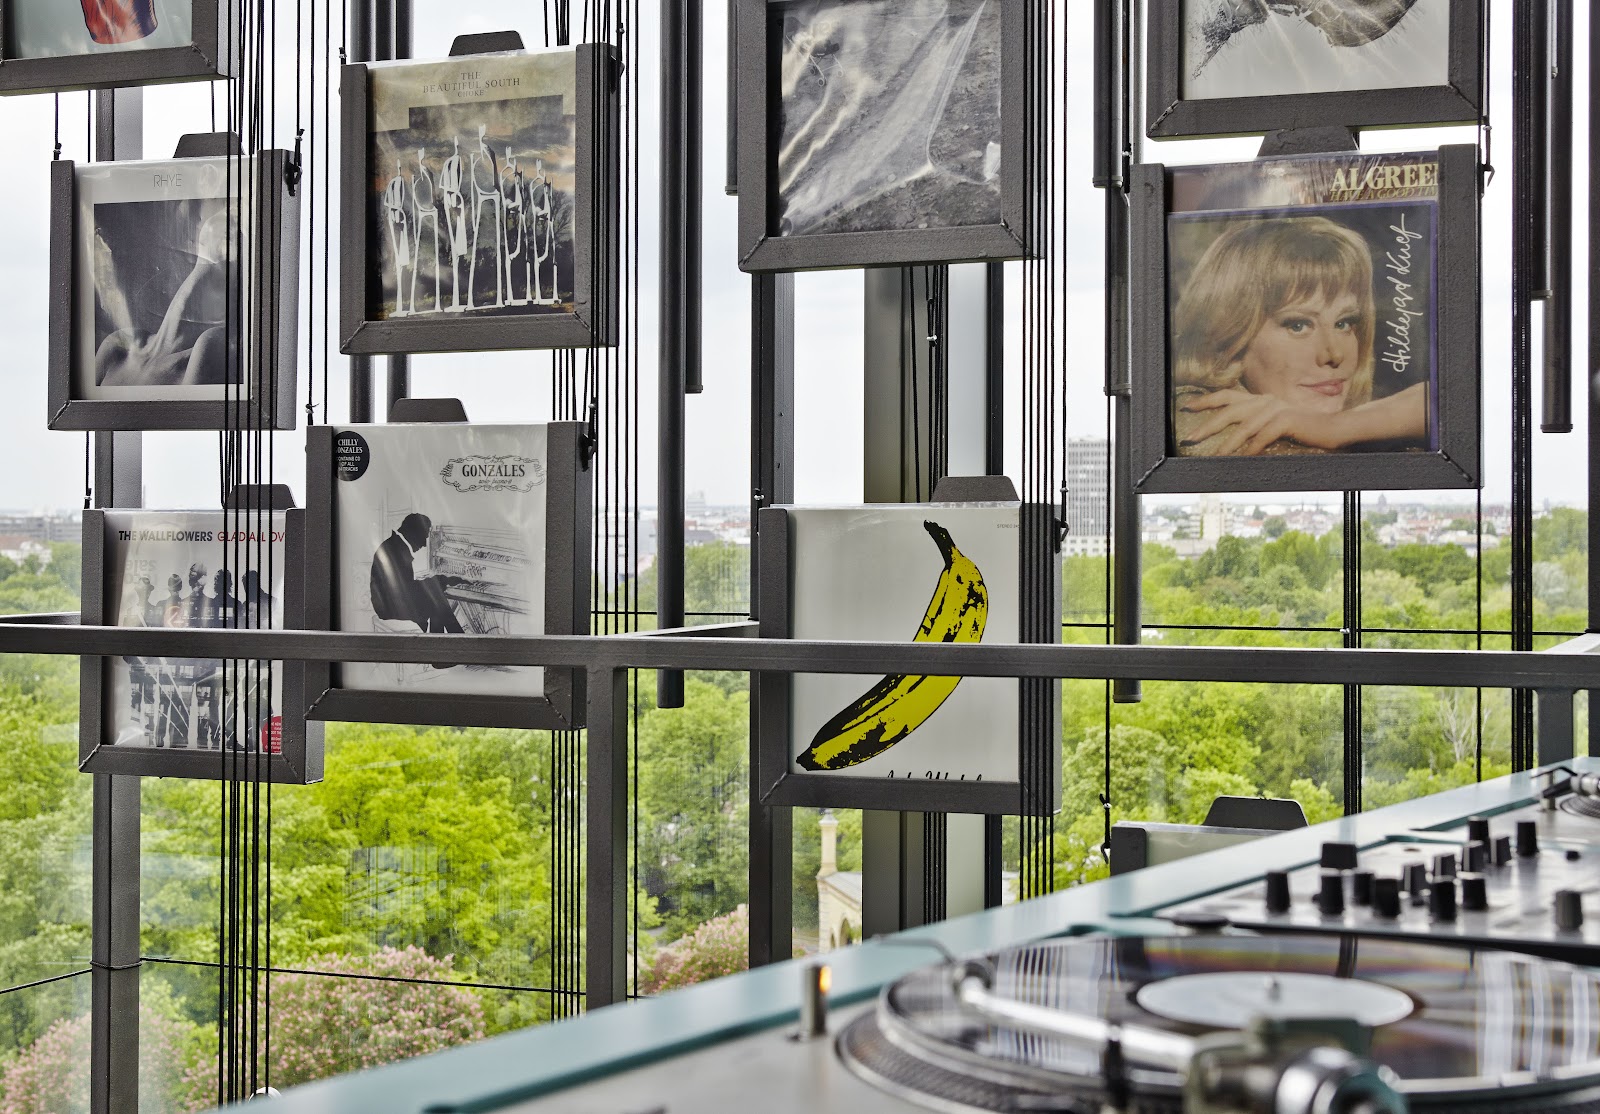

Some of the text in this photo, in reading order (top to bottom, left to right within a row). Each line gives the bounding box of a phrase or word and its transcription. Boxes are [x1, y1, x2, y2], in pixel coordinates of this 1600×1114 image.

[461, 72, 481, 80] THE
[423, 78, 520, 93] BEAUTIFUL SOUTH
[153, 173, 182, 187] RHYE
[1330, 167, 1365, 192] AL
[1377, 187, 1415, 200] GOOD
[337, 438, 359, 446] CHILLY
[337, 446, 363, 454] ONZALES
[462, 464, 526, 477] GONZALES
[118, 530, 137, 541] THE
[139, 530, 213, 542] WALLFLOWERS
[248, 531, 266, 542] AL
